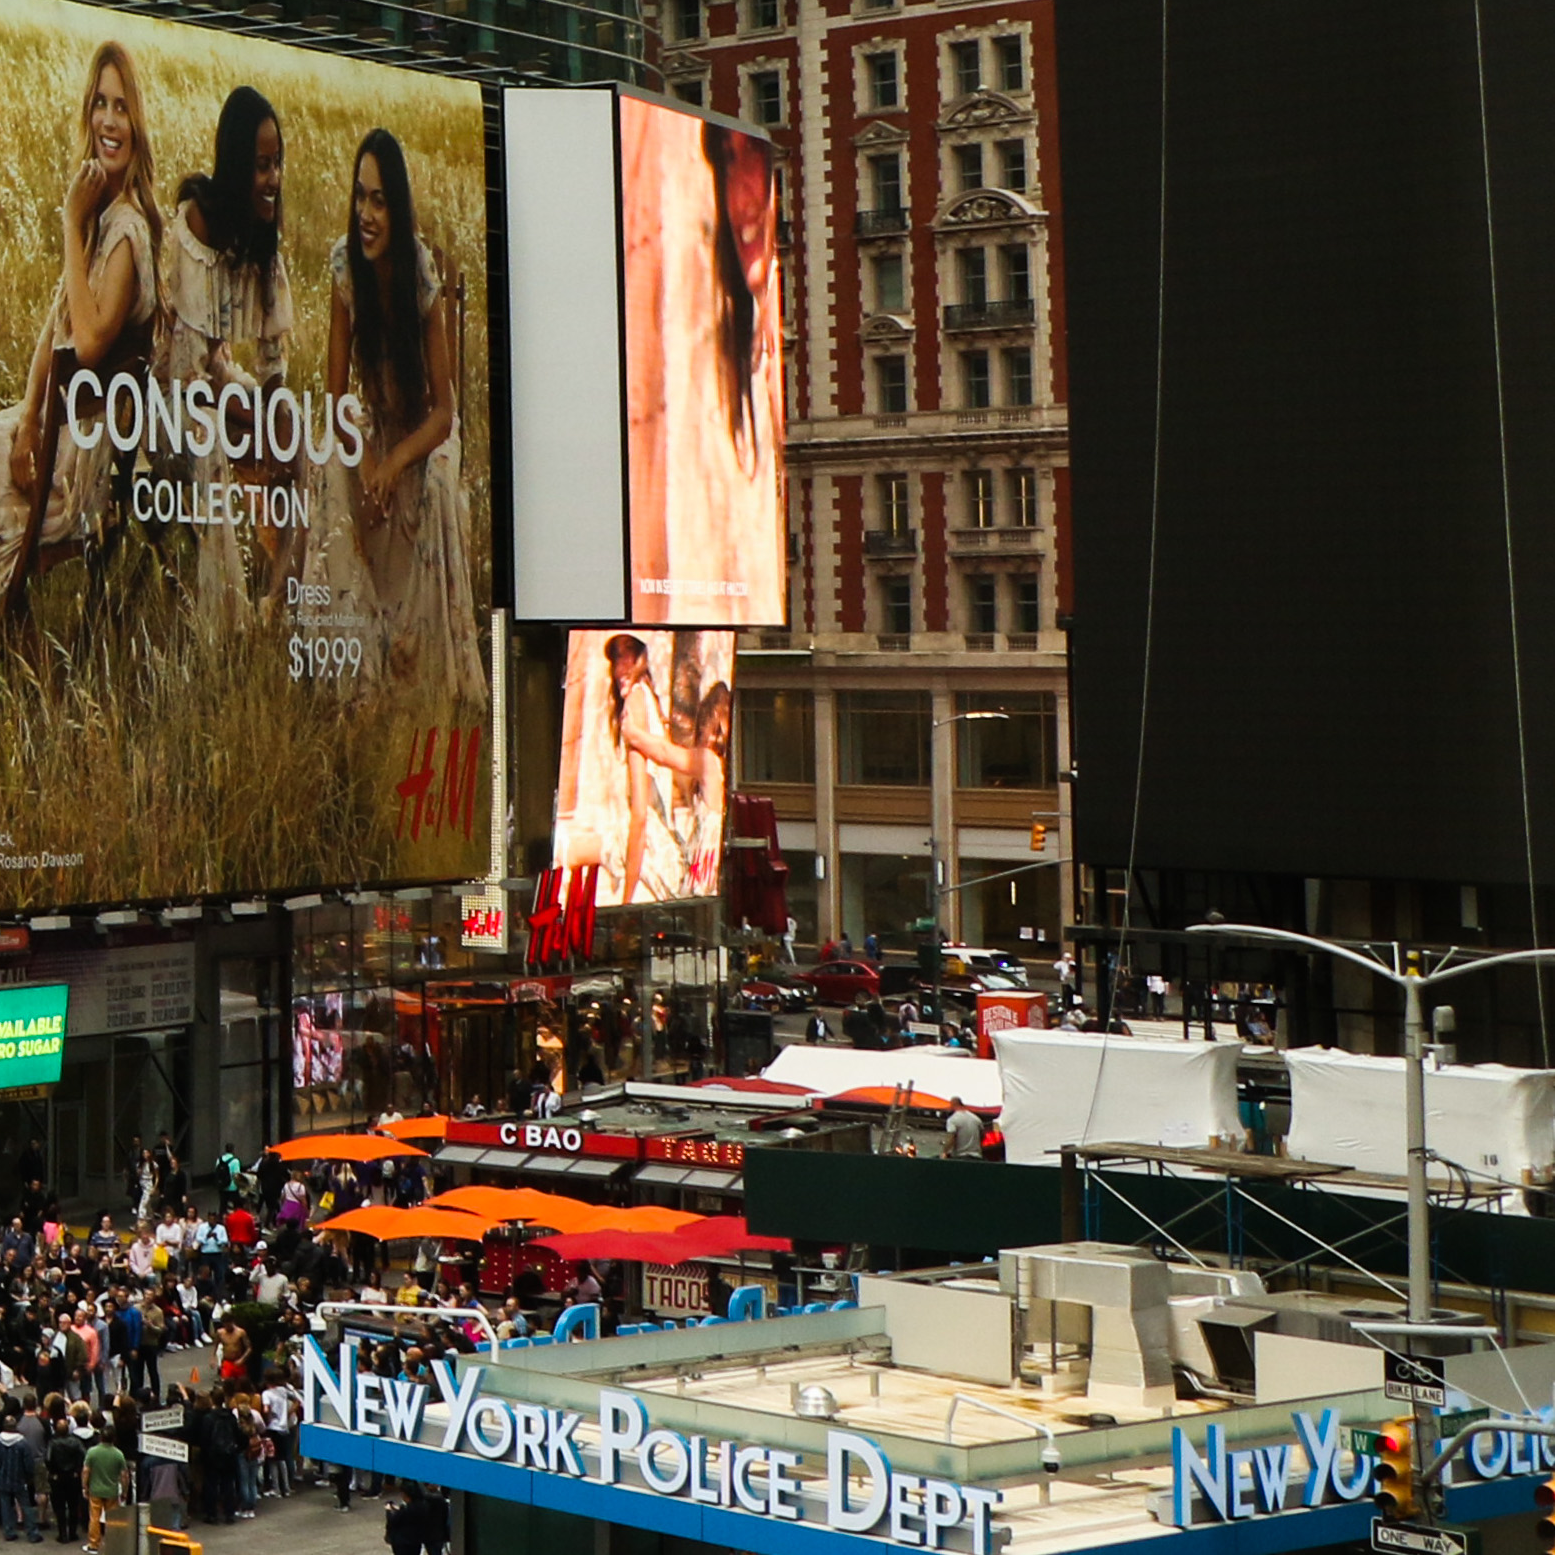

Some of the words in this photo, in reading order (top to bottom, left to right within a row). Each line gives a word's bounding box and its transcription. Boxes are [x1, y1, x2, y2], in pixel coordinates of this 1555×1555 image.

[67, 368, 364, 469] CONSCIOUS
[133, 477, 310, 529] COLLECTION
[287, 576, 331, 605] Dress
[289, 631, 362, 683] $19.99
[395, 725, 481, 843] H&M
[42, 850, 84, 868] Dawson
[527, 862, 599, 964] H&M
[17, 1037, 60, 1057] SUGAR
[500, 1122, 517, 1145] C
[525, 1124, 582, 1152] BAO
[661, 1138, 743, 1164] TAQU
[1387, 1382, 1411, 1399] BIKE
[1414, 1387, 1443, 1403] LANE
[303, 1333, 430, 1441] NEW
[430, 1359, 586, 1477] YORK
[600, 1388, 803, 1520] POLICE
[827, 1429, 1003, 1555] DEPT
[1172, 1421, 1291, 1528] NEW
[1291, 1407, 1383, 1501] YO
[1380, 1529, 1408, 1545] ONE
[1423, 1536, 1453, 1552] WAY
